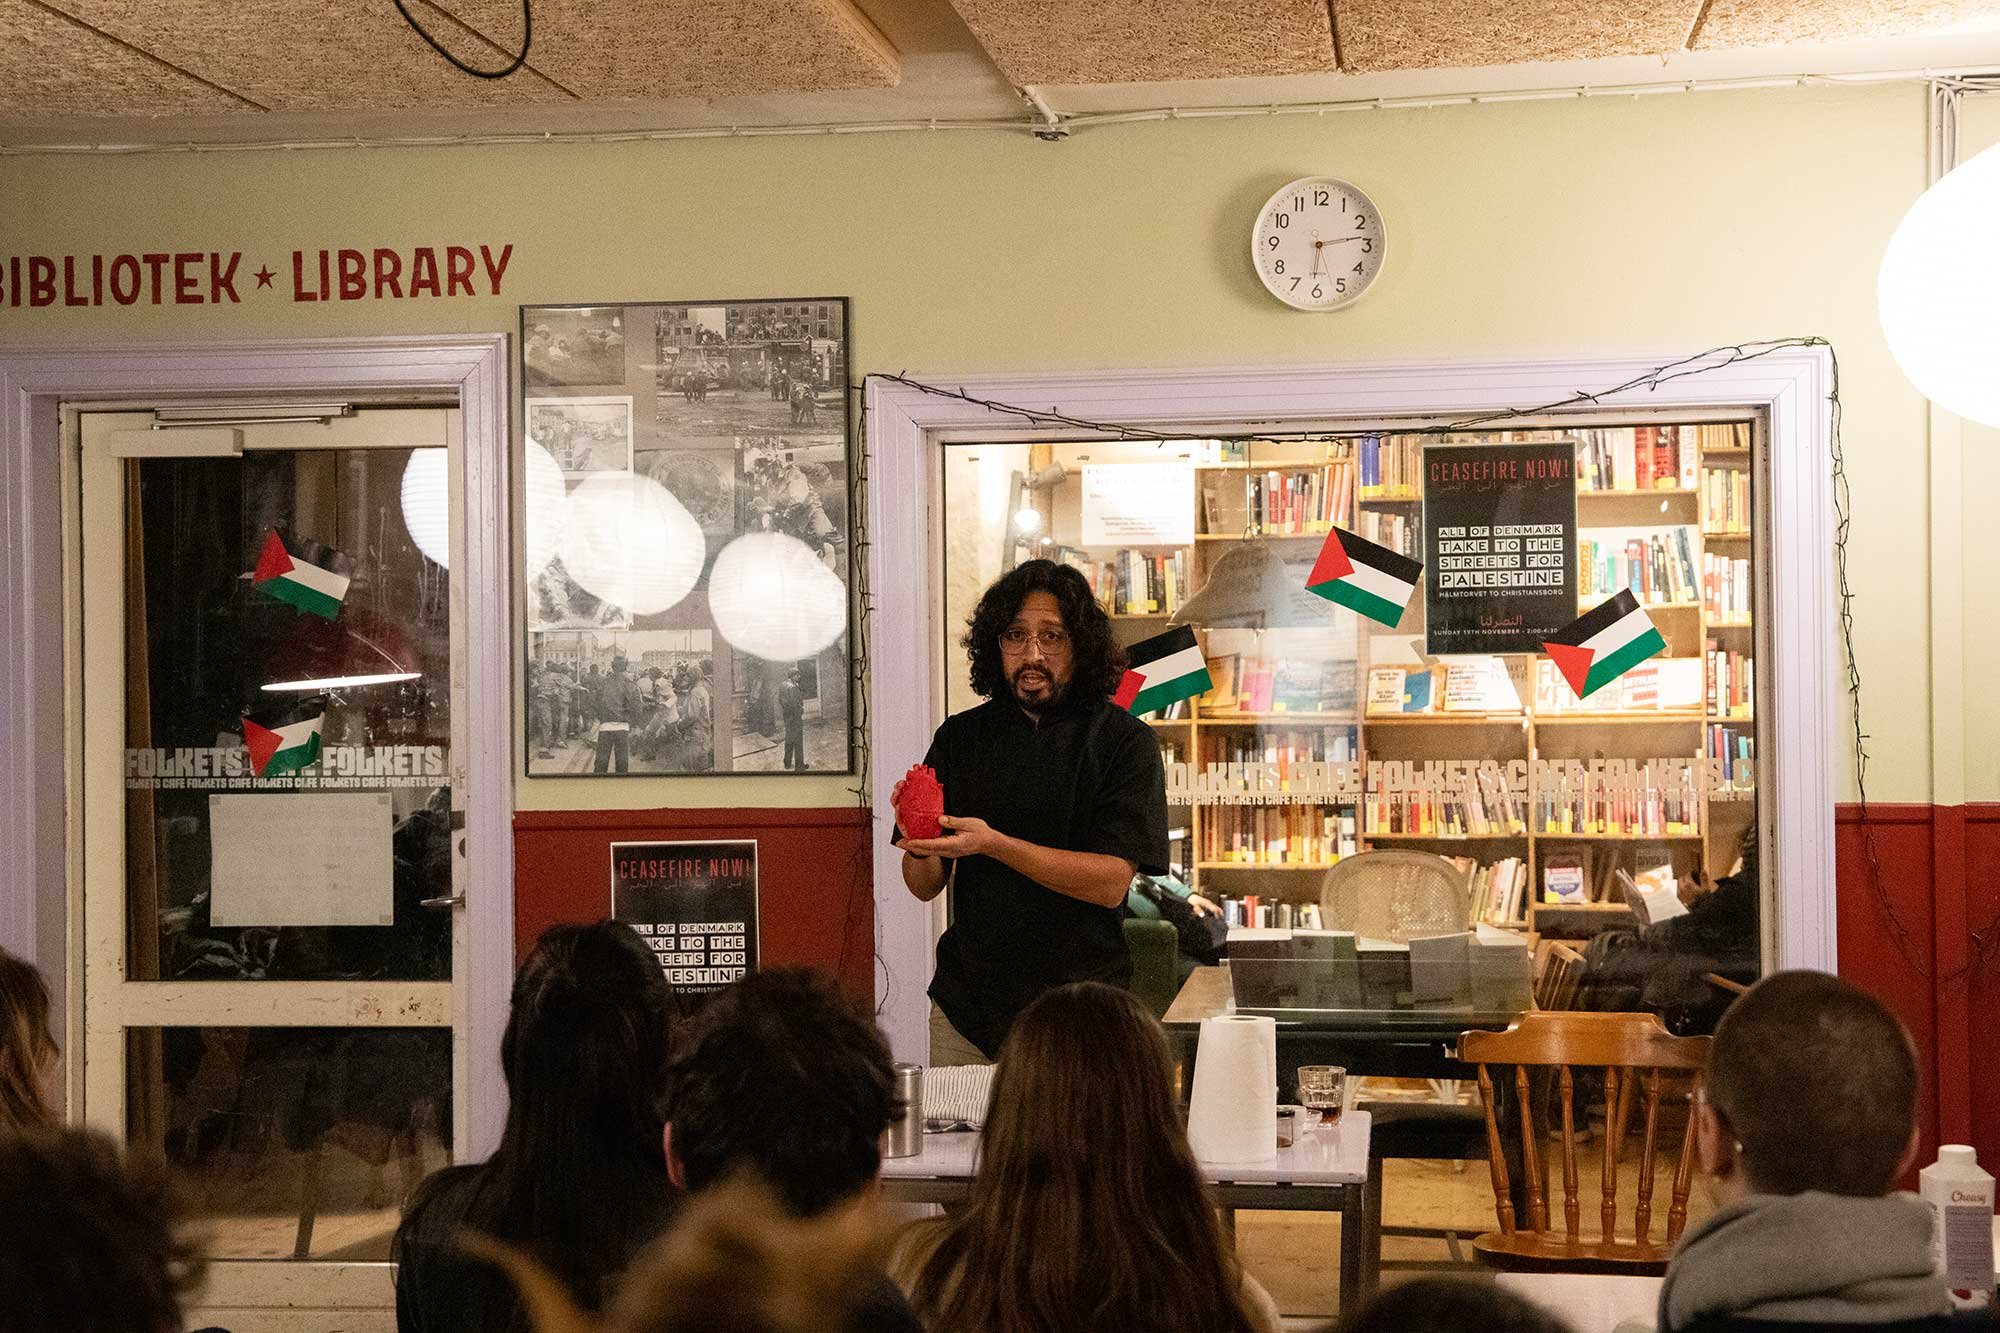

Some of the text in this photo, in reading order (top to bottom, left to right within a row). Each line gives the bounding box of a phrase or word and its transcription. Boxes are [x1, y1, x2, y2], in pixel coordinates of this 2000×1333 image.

[1294, 196, 1304, 212] 11
[1314, 191, 1329, 206] 12
[1275, 213, 1289, 229] 10
[1354, 215, 1366, 230] 2
[1268, 236, 1280, 251] 9
[1361, 238, 1373, 253] 3
[1274, 259, 1285, 274] 8
[1352, 261, 1364, 275] 4
[0, 244, 513, 307] IBLIOTEK LIBRARY
[1290, 277, 1302, 292] 7
[1311, 283, 1322, 298] 6
[1335, 278, 1346, 293] 5
[1431, 458, 1568, 481] CEASEFIRE NOW!
[1439, 525, 1563, 537] ALL OF DENMARK
[1439, 538, 1563, 553] TAKE TO THE
[1440, 554, 1563, 569] STREETS FOR
[1441, 571, 1563, 587] PALESTINE
[1439, 590, 1487, 598] HALMTORVET
[1501, 589, 1563, 597] CHRISTIANSBORG
[125, 748, 243, 776] FOLKETS
[323, 745, 442, 776] FOLKETS
[162, 778, 186, 789] CAFE
[187, 778, 227, 788] FOLKETS
[229, 778, 251, 788] CAFE
[253, 778, 293, 788] FOLKETS
[320, 777, 360, 788] FOLKETS
[362, 777, 385, 788] CAFE
[386, 777, 426, 788] FOLKETS
[1167, 761, 1280, 792] OLKETS
[1367, 759, 1499, 791] FOLKETS
[1168, 795, 1192, 806] KETS
[620, 858, 750, 879] CEASEFIRE NOW!
[657, 924, 675, 934] OF
[680, 923, 744, 934] DENMARK
[652, 936, 744, 949] KE TO THE
[662, 952, 745, 965] EETS FOR
